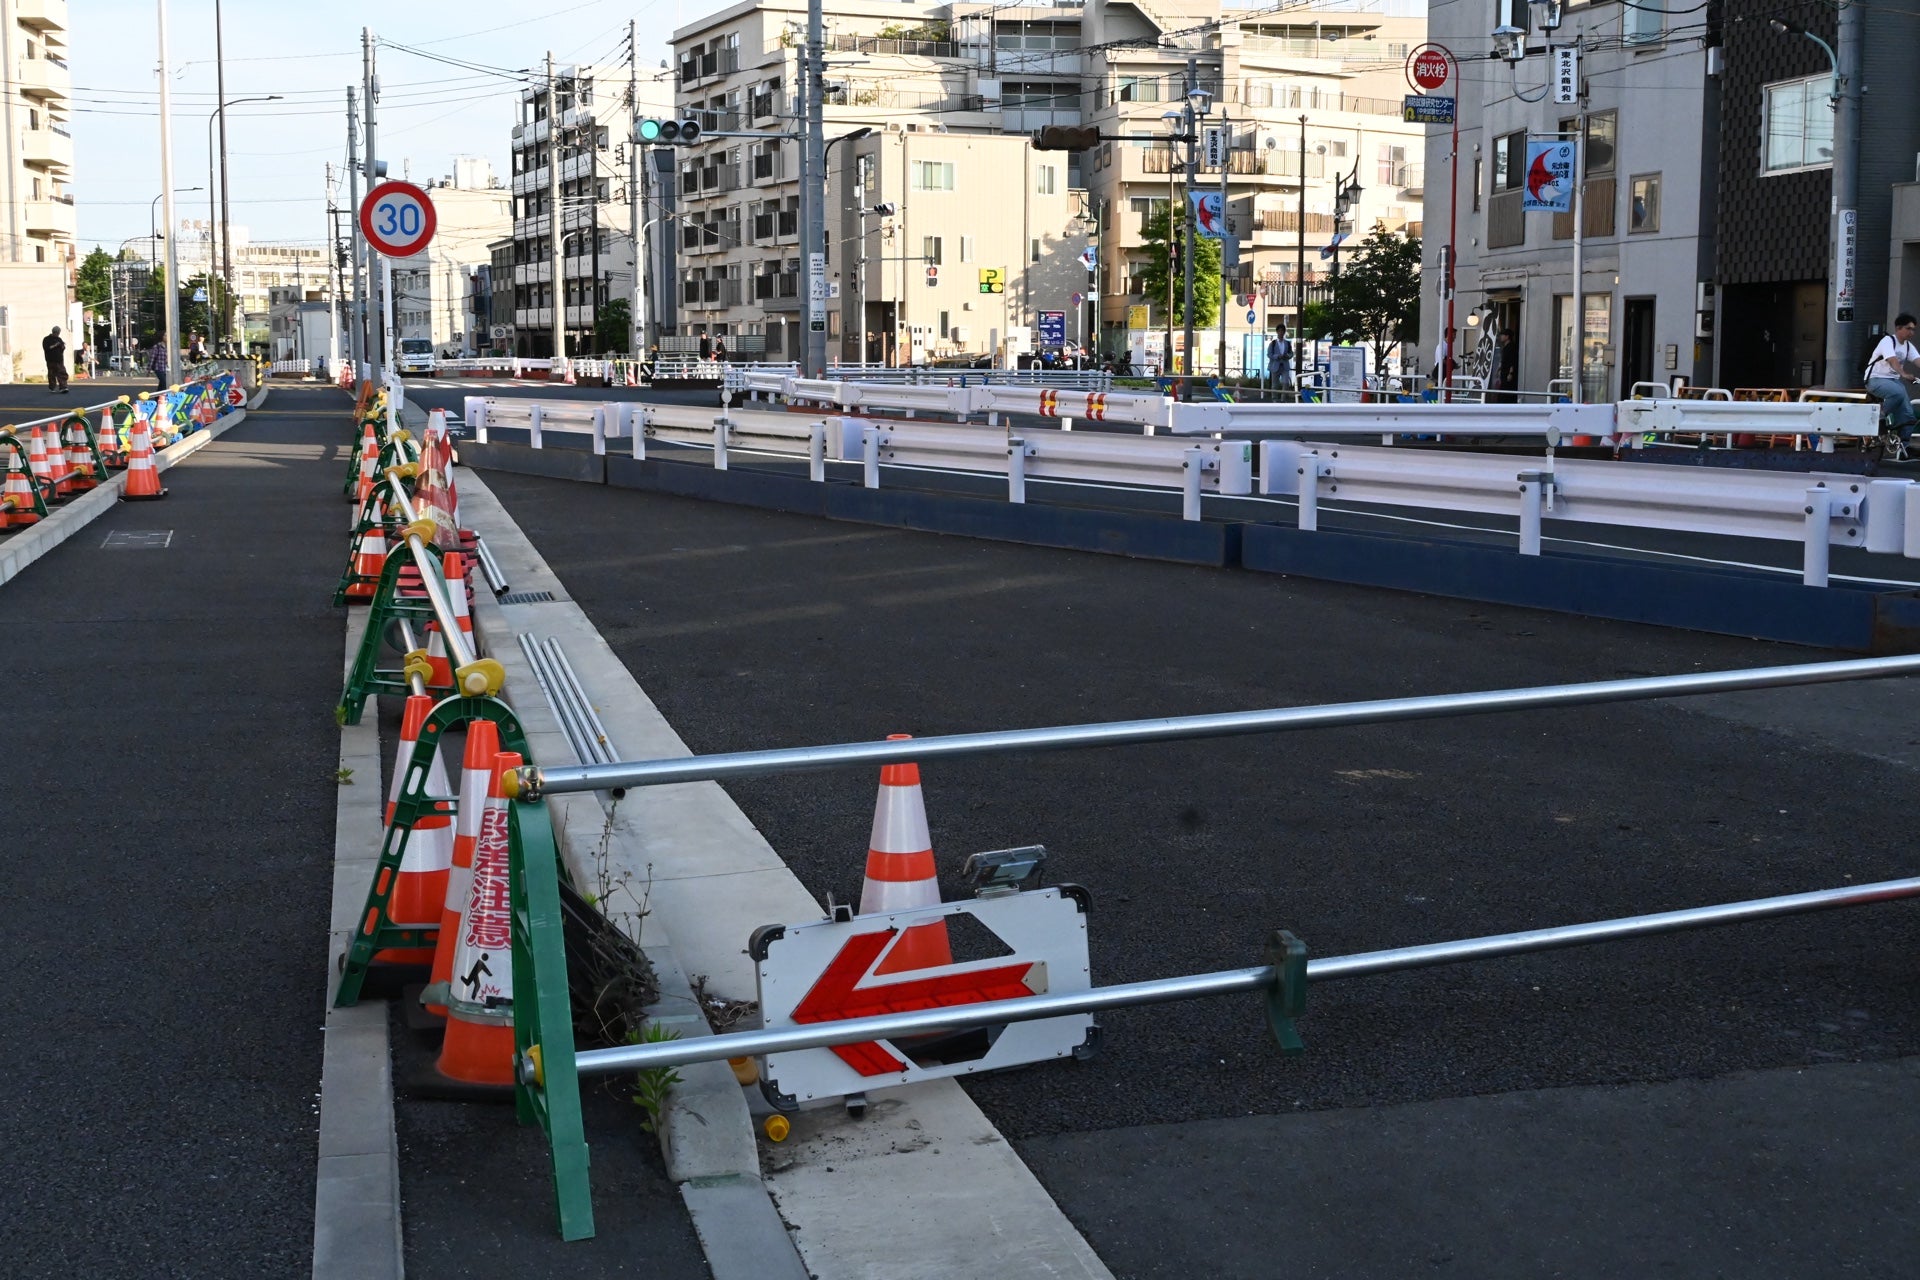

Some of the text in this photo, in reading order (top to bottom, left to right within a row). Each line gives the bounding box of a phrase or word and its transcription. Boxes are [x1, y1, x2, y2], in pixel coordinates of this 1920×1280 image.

[1416, 62, 1446, 78] 消火栓
[1561, 51, 1571, 101] 東北沢商和会
[378, 203, 420, 236] 30
